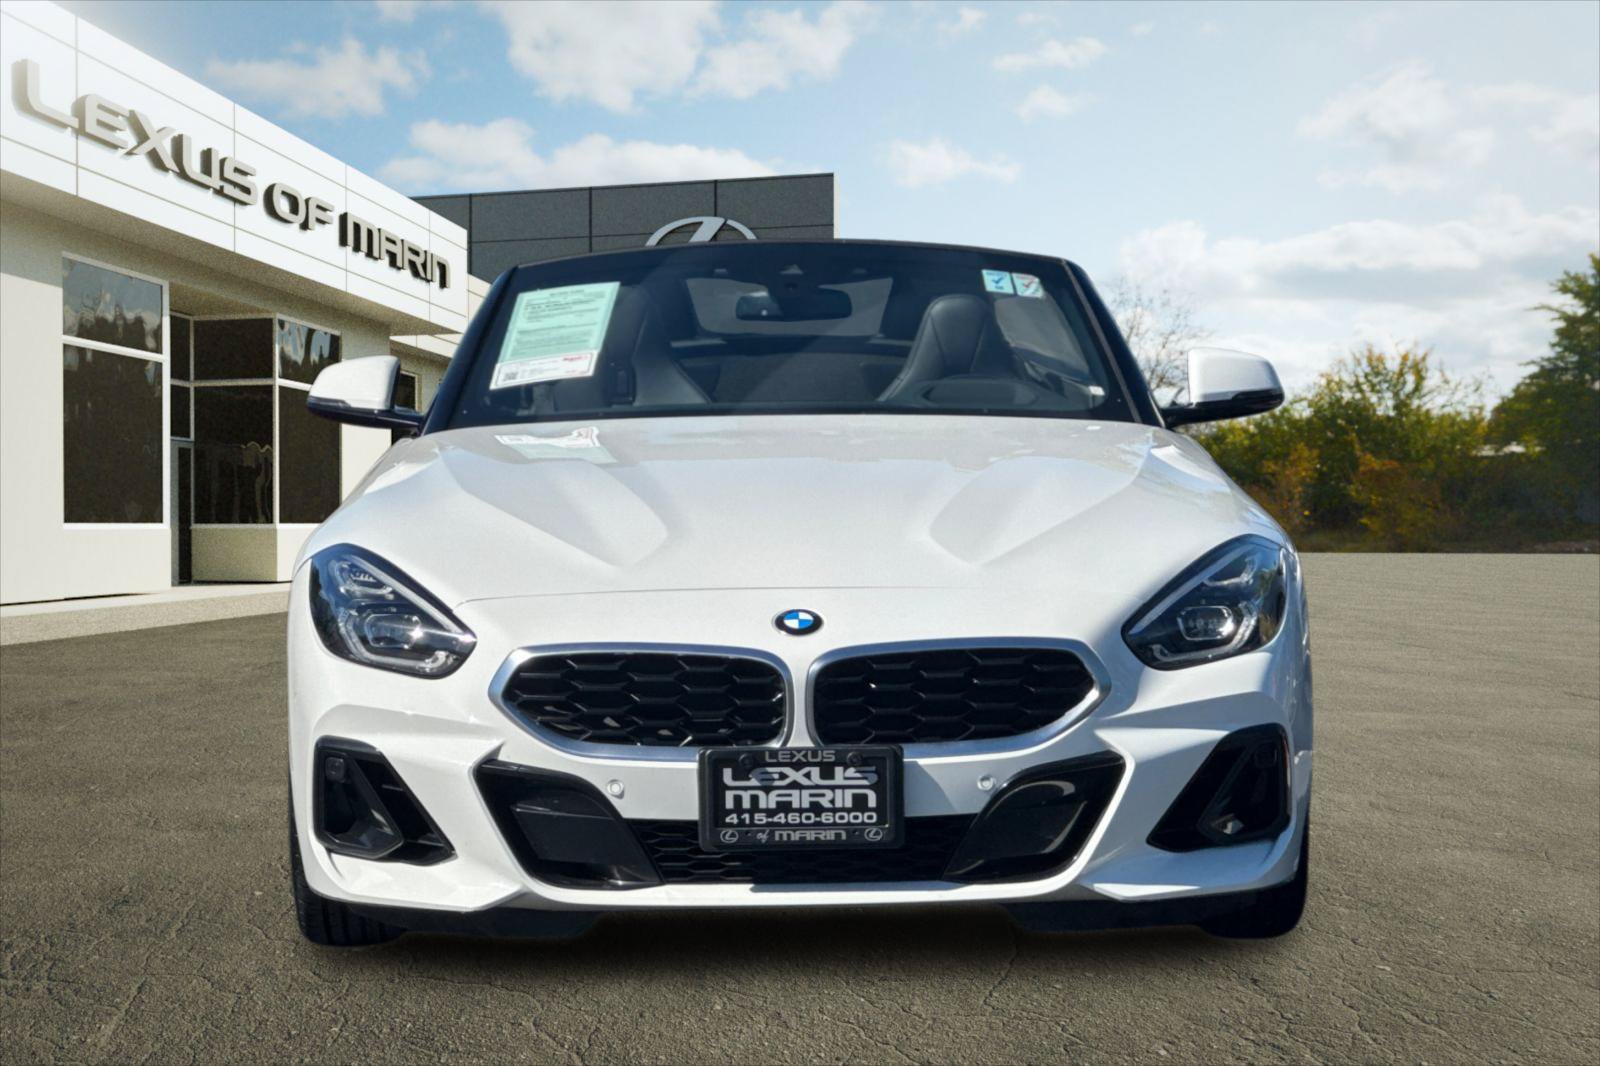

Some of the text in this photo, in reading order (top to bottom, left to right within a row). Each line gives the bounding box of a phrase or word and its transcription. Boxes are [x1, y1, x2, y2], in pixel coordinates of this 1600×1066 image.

[11, 58, 450, 289] LEXUS OF MARIN
[765, 750, 836, 763] LEXUS
[722, 766, 878, 787] LEXUS
[725, 788, 877, 810] MARIN
[725, 811, 878, 825] 415-460-6000
[774, 829, 847, 841] MARIN
